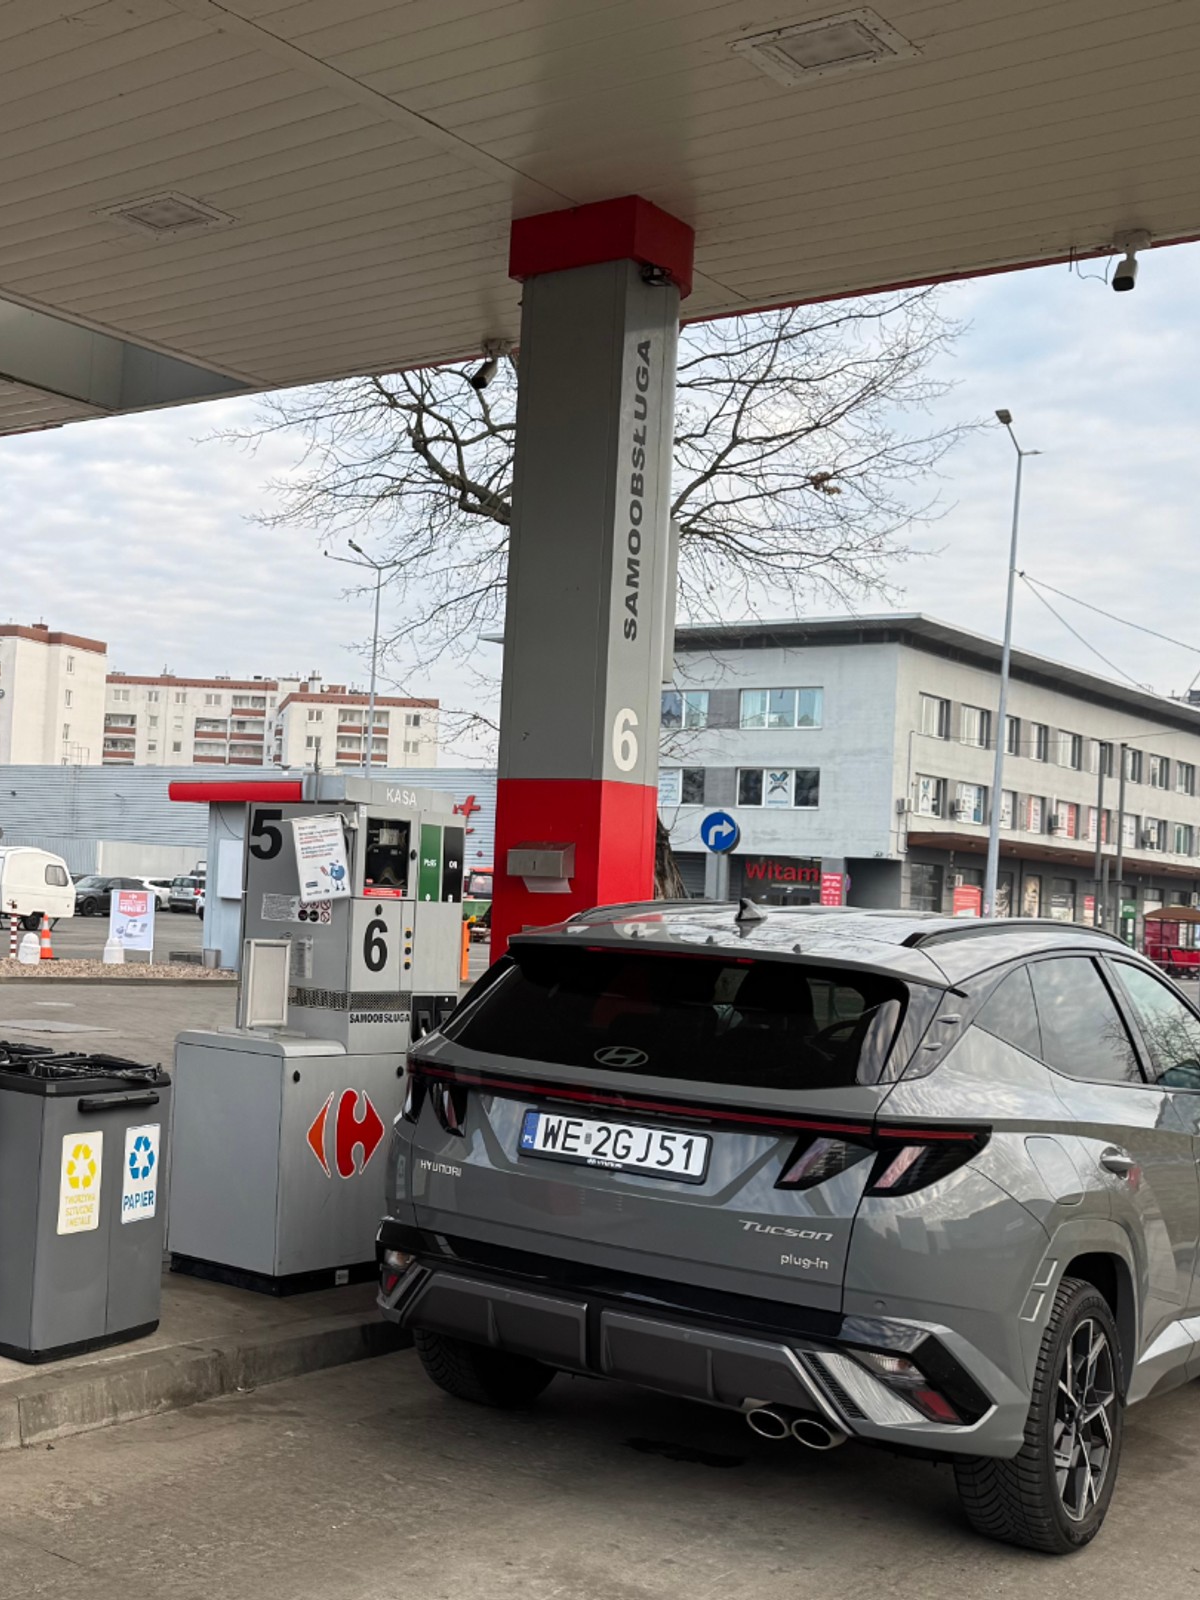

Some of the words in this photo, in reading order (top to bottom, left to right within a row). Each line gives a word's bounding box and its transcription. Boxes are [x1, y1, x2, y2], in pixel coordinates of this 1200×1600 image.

[624, 340, 651, 641] SAMOOBSŁUGA
[612, 708, 639, 772] 6
[386, 788, 417, 806] KASA
[250, 809, 282, 860] 5
[364, 919, 388, 972] 6
[350, 1012, 410, 1024] SAMOOBSŁUGA
[542, 1117, 583, 1153] WE
[592, 1126, 694, 1170] 2GJ51
[420, 1159, 462, 1176] HYUNDAI
[123, 1190, 154, 1211] PAPIER
[780, 1253, 829, 1270] plug-in
